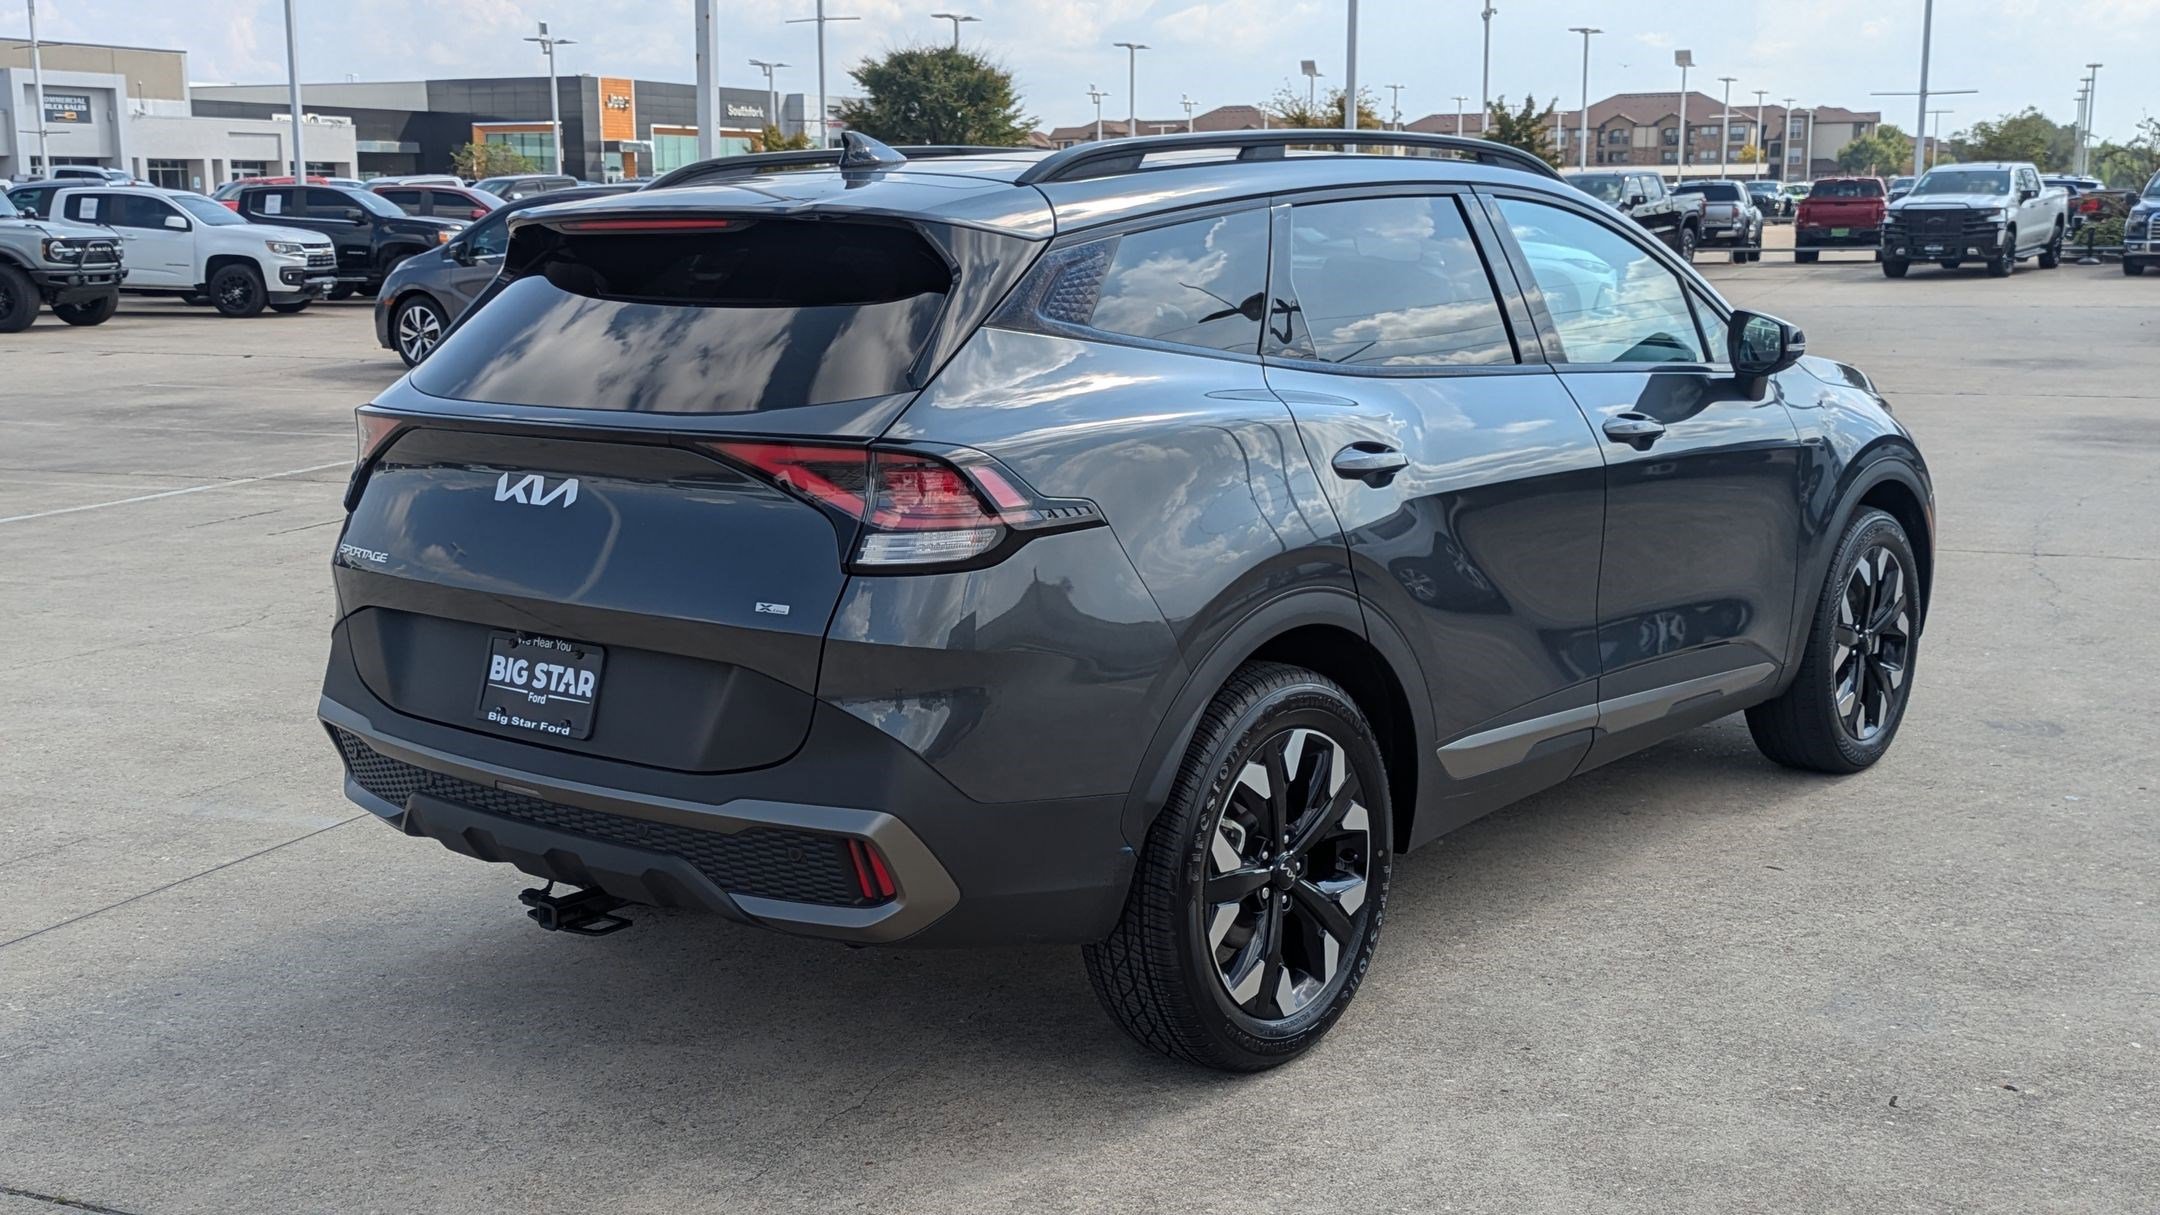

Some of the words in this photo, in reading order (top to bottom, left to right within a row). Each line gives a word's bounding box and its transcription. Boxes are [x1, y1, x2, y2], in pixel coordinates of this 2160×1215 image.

[43, 96, 85, 104] OMMERCIAL
[727, 104, 764, 118] Southfork
[494, 472, 579, 508] KIA
[340, 543, 389, 563] SPORTAGE
[532, 636, 554, 649] Hear
[555, 639, 572, 652] You
[489, 654, 529, 685] BIG
[531, 662, 595, 698] STAR
[527, 692, 547, 704] Ford
[488, 712, 508, 725] Big
[511, 716, 537, 729] Star
[539, 722, 570, 736] Ford
